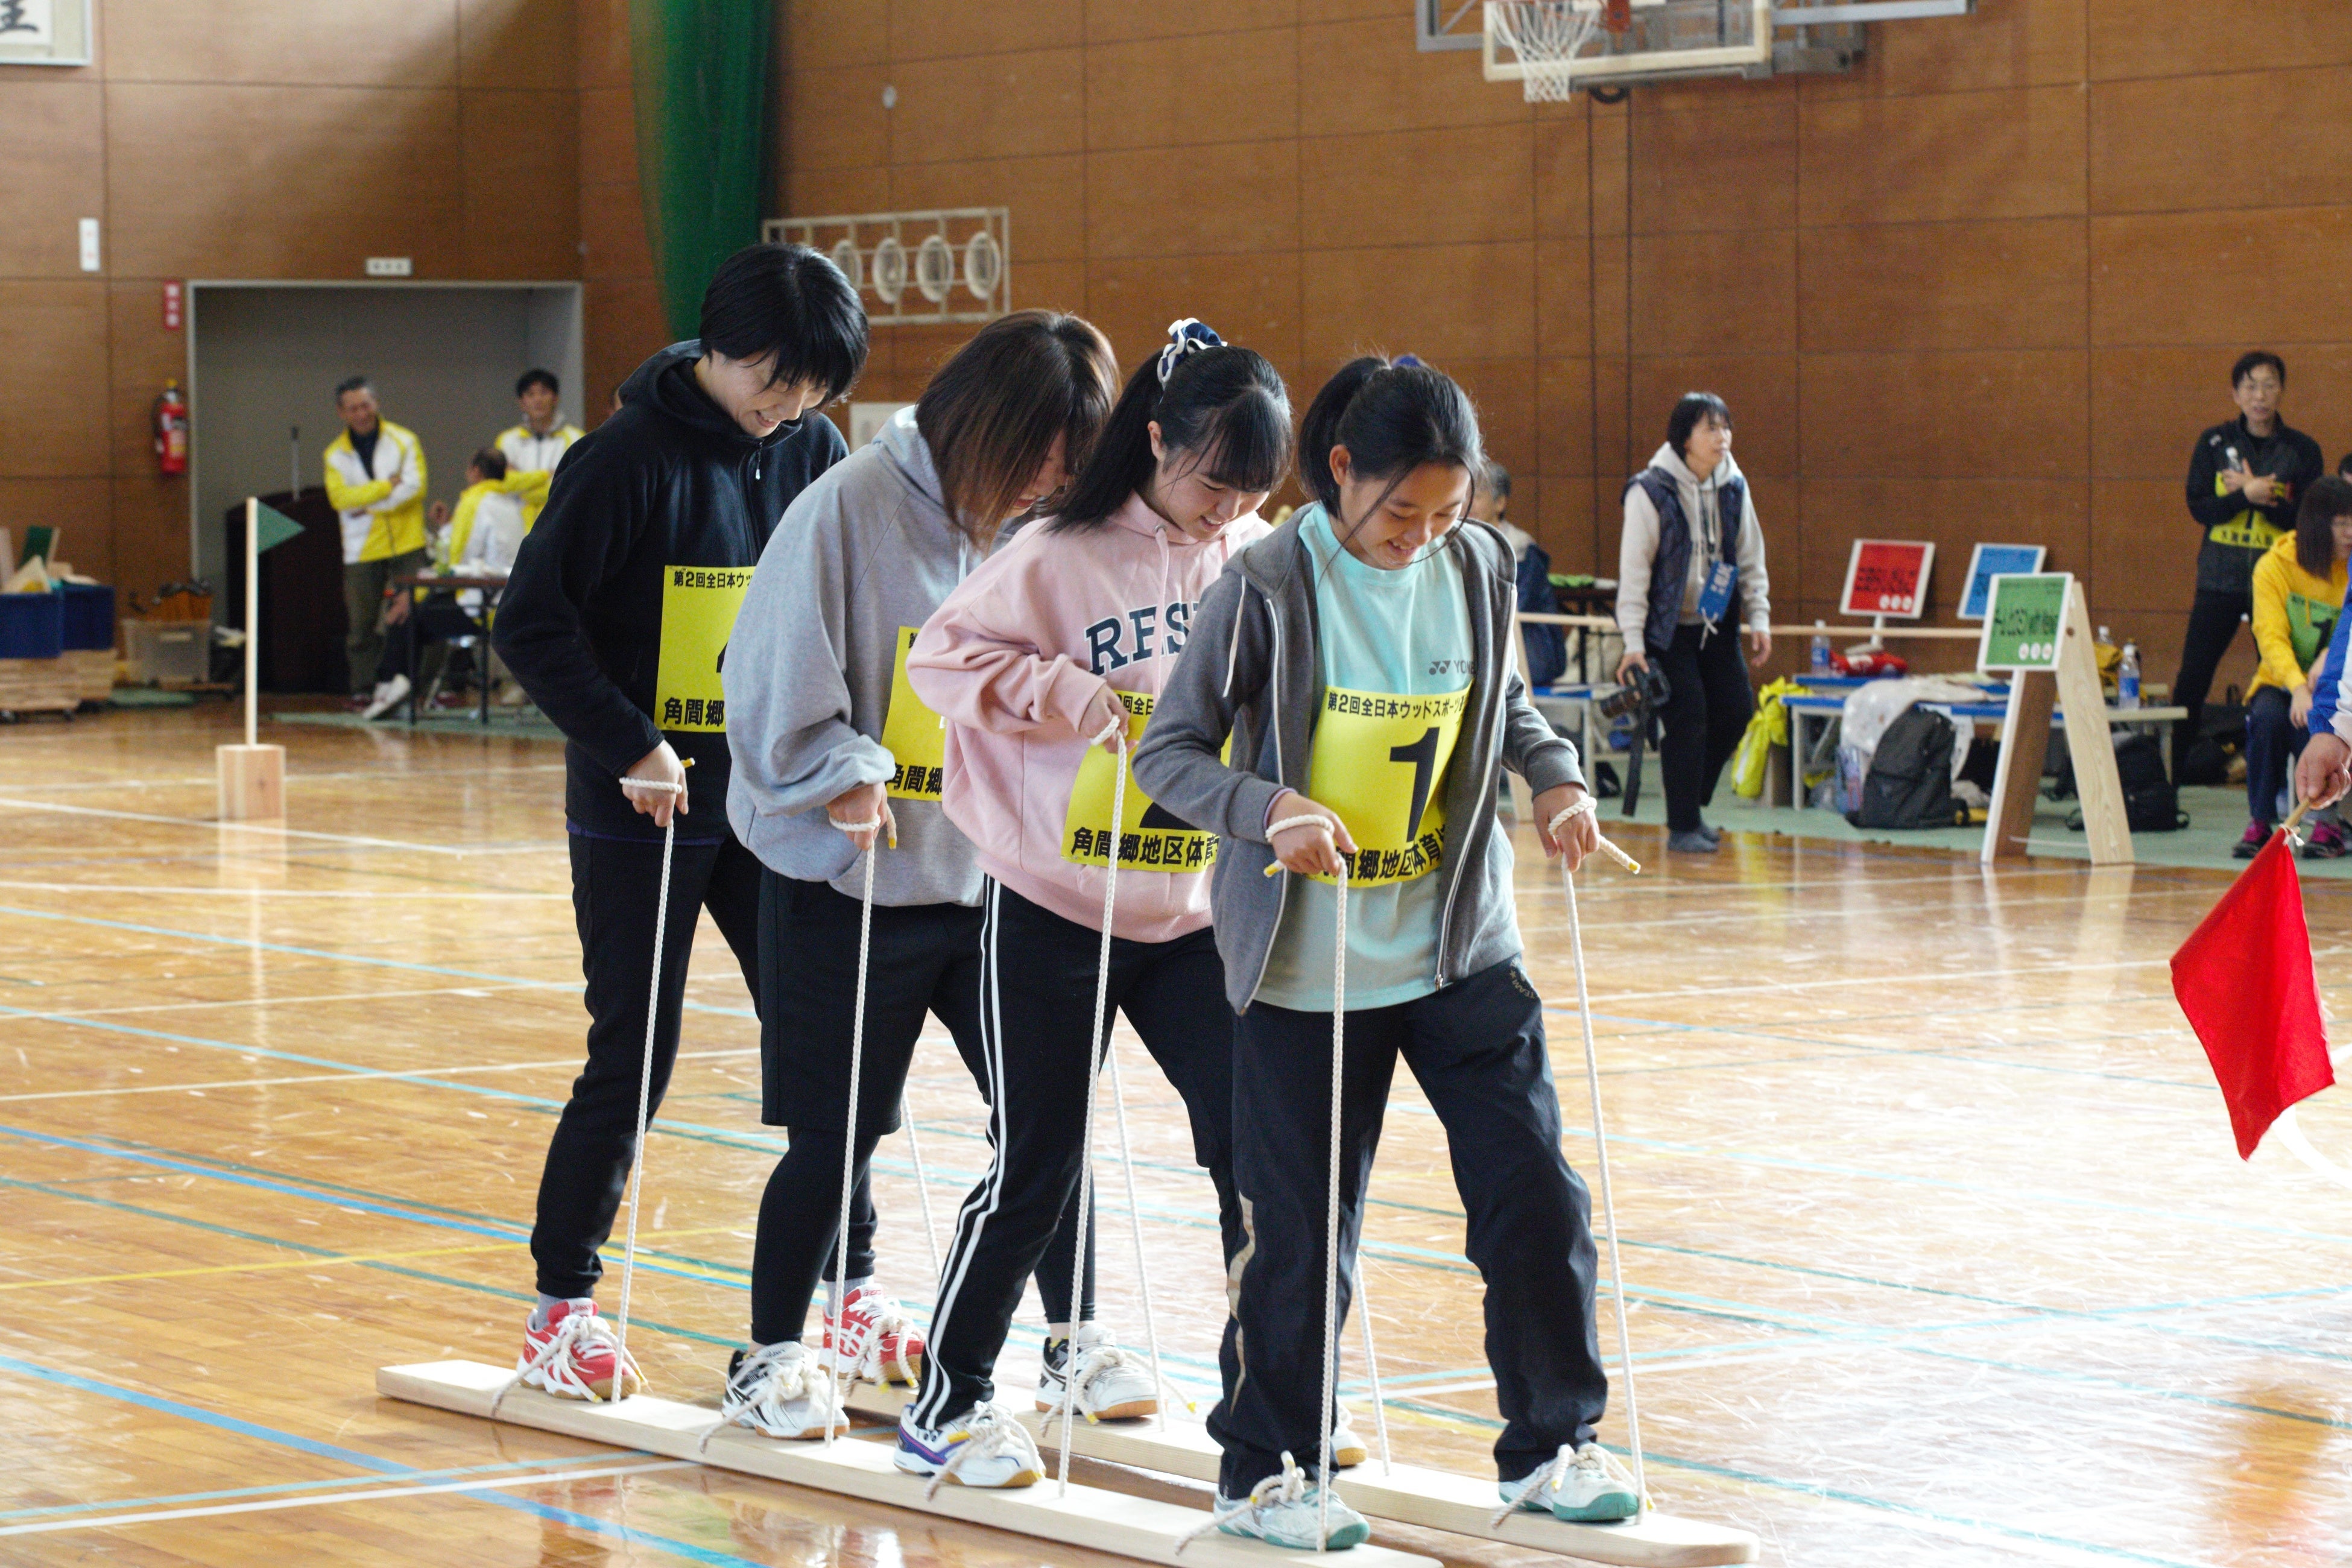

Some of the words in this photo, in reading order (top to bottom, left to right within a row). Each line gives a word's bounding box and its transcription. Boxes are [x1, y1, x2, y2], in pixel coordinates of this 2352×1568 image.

[1084, 601, 1200, 676] RES
[1116, 694, 1153, 716] 回全日
[1389, 727, 1440, 843] 1
